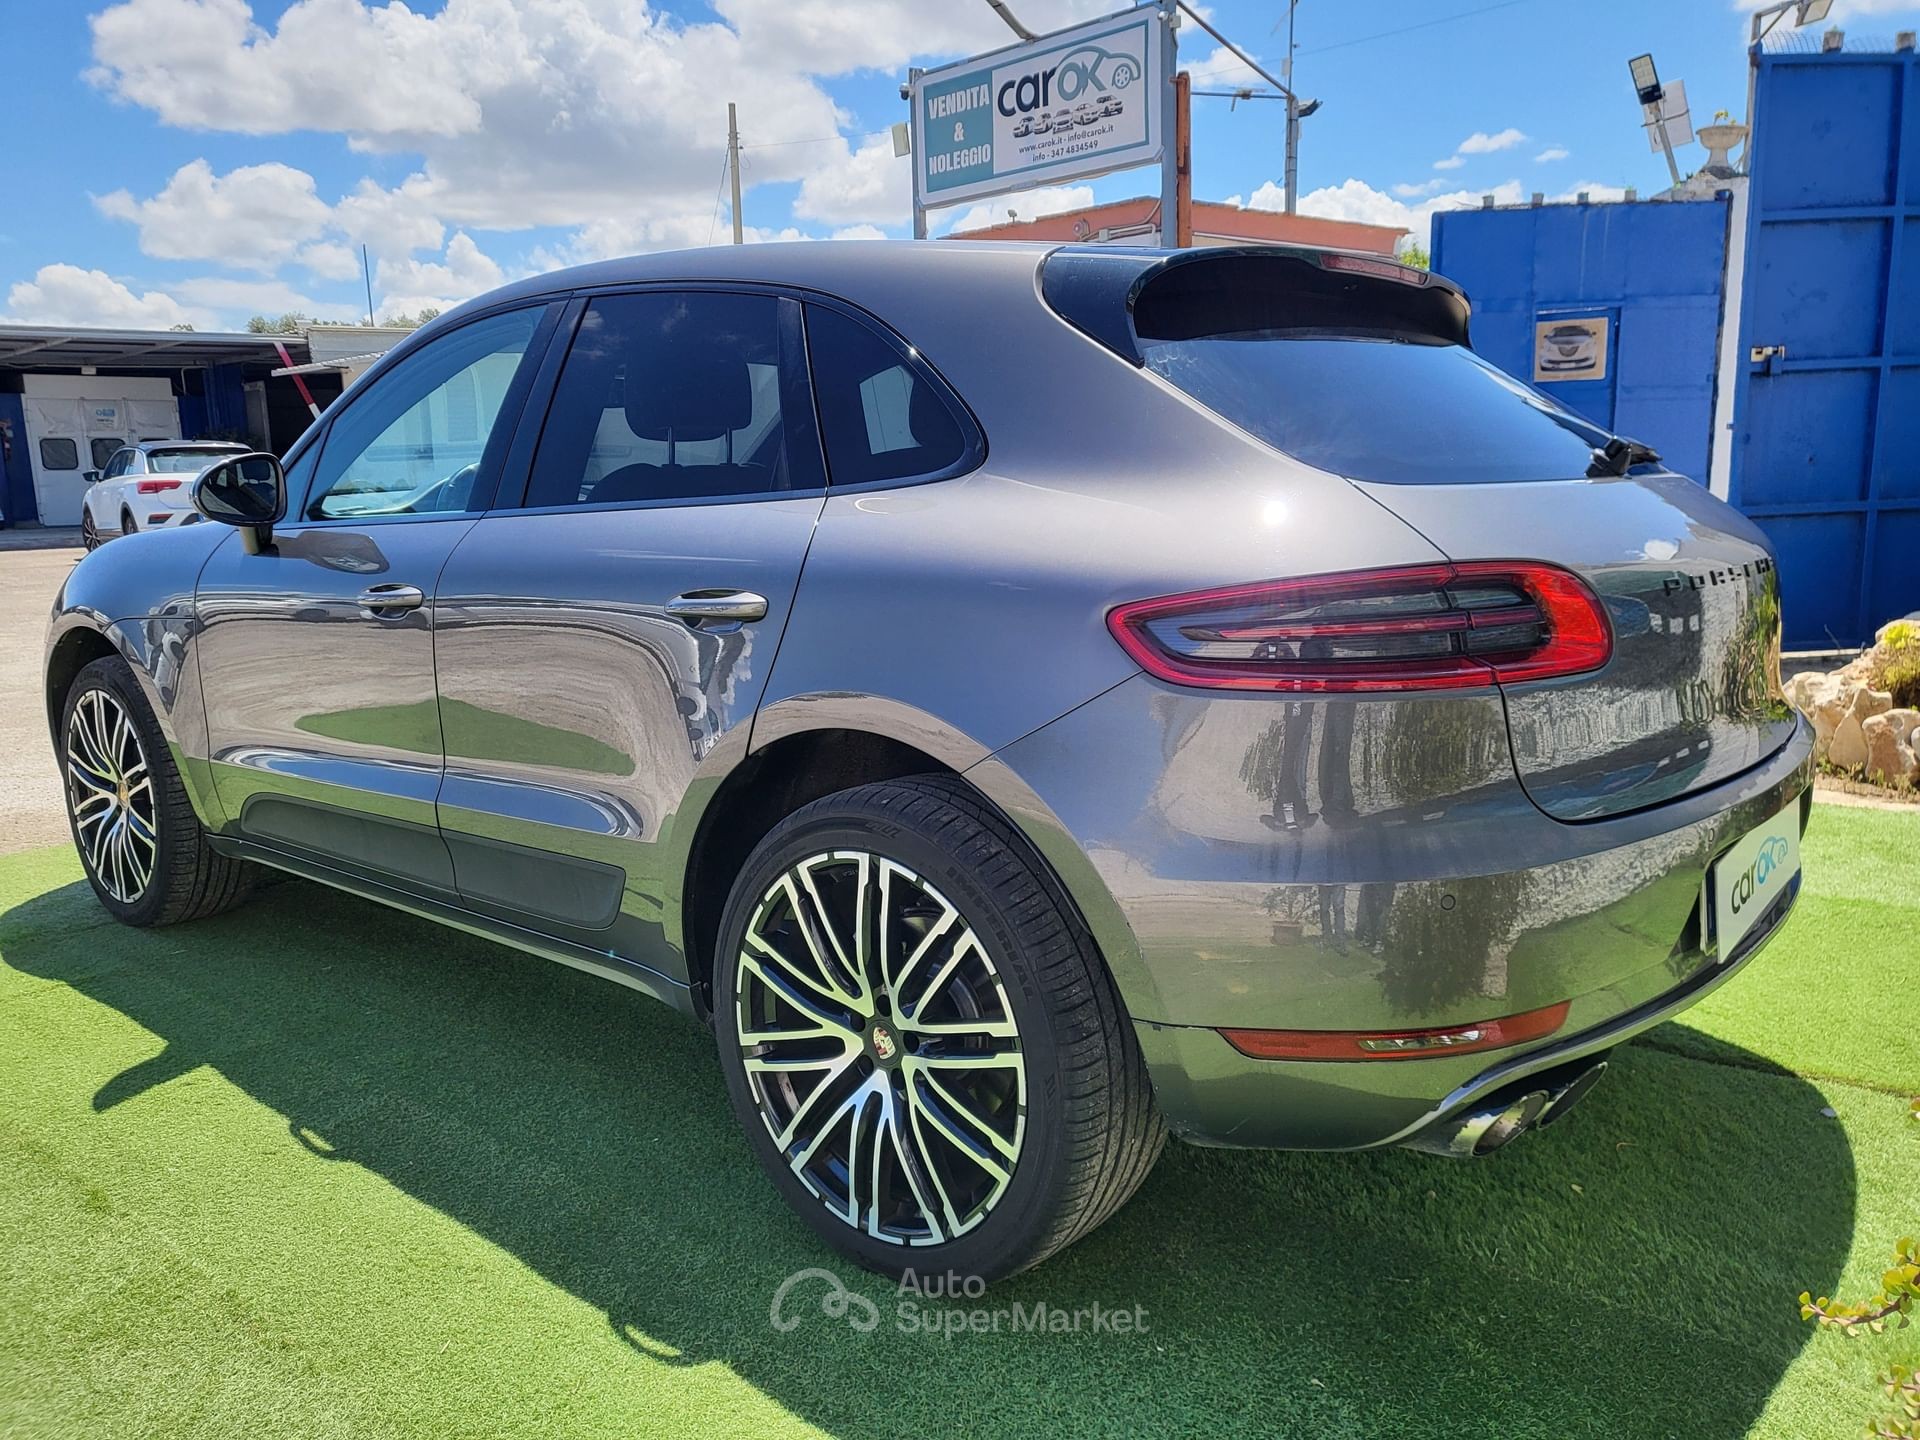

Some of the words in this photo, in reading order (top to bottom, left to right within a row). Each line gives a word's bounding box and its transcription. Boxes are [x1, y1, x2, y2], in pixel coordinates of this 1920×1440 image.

[928, 83, 990, 120] VENDITA
[954, 122, 964, 142] &
[1019, 136, 1062, 153] www.carok.it
[1067, 124, 1114, 142] info@carok.it
[929, 144, 991, 175] NOLEGGIO
[1032, 152, 1046, 163] info
[1051, 147, 1065, 158] 347
[1065, 139, 1099, 154] 4834549
[945, 865, 1034, 1002] IMPERIAL
